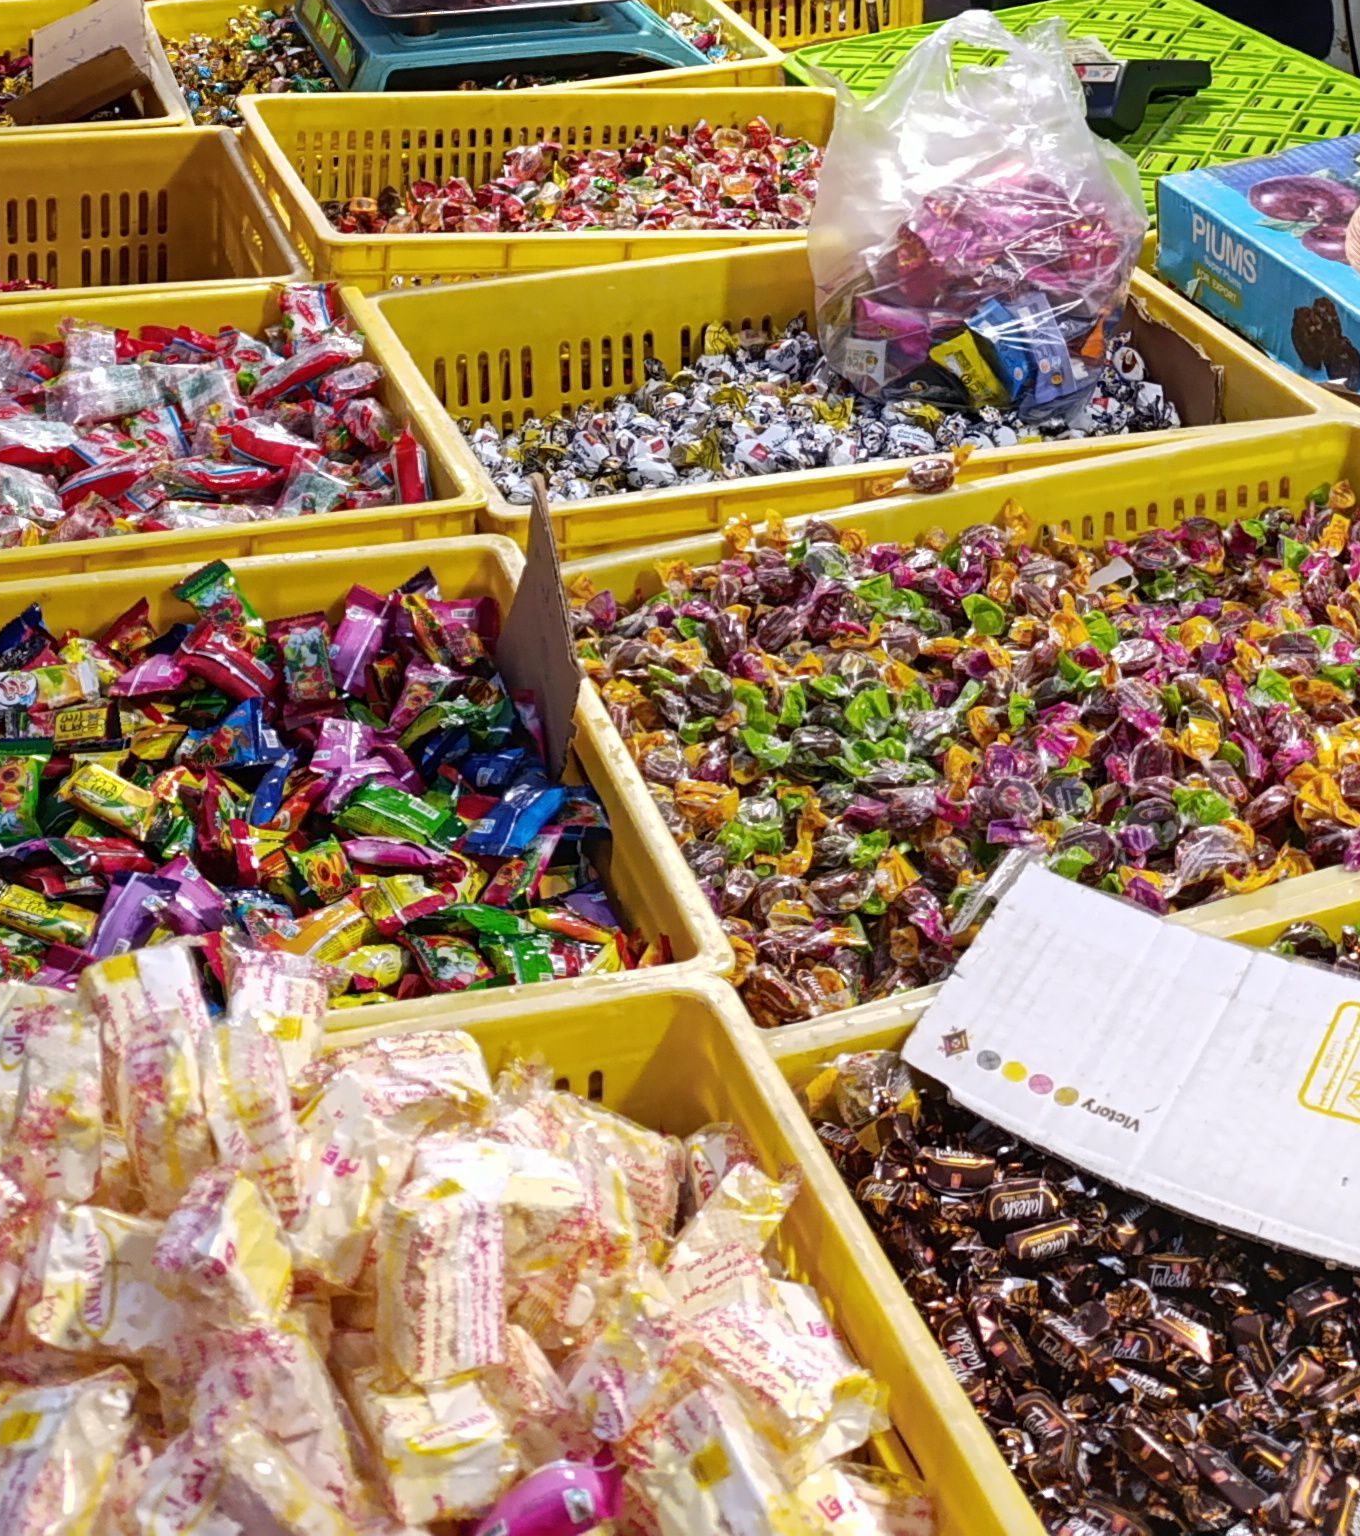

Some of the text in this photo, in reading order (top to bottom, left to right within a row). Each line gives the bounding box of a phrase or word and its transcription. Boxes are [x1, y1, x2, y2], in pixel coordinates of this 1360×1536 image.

[1080, 1098, 1141, 1134] Victory
[1001, 1195, 1045, 1219] Talesh
[1149, 1264, 1191, 1289] Talesh
